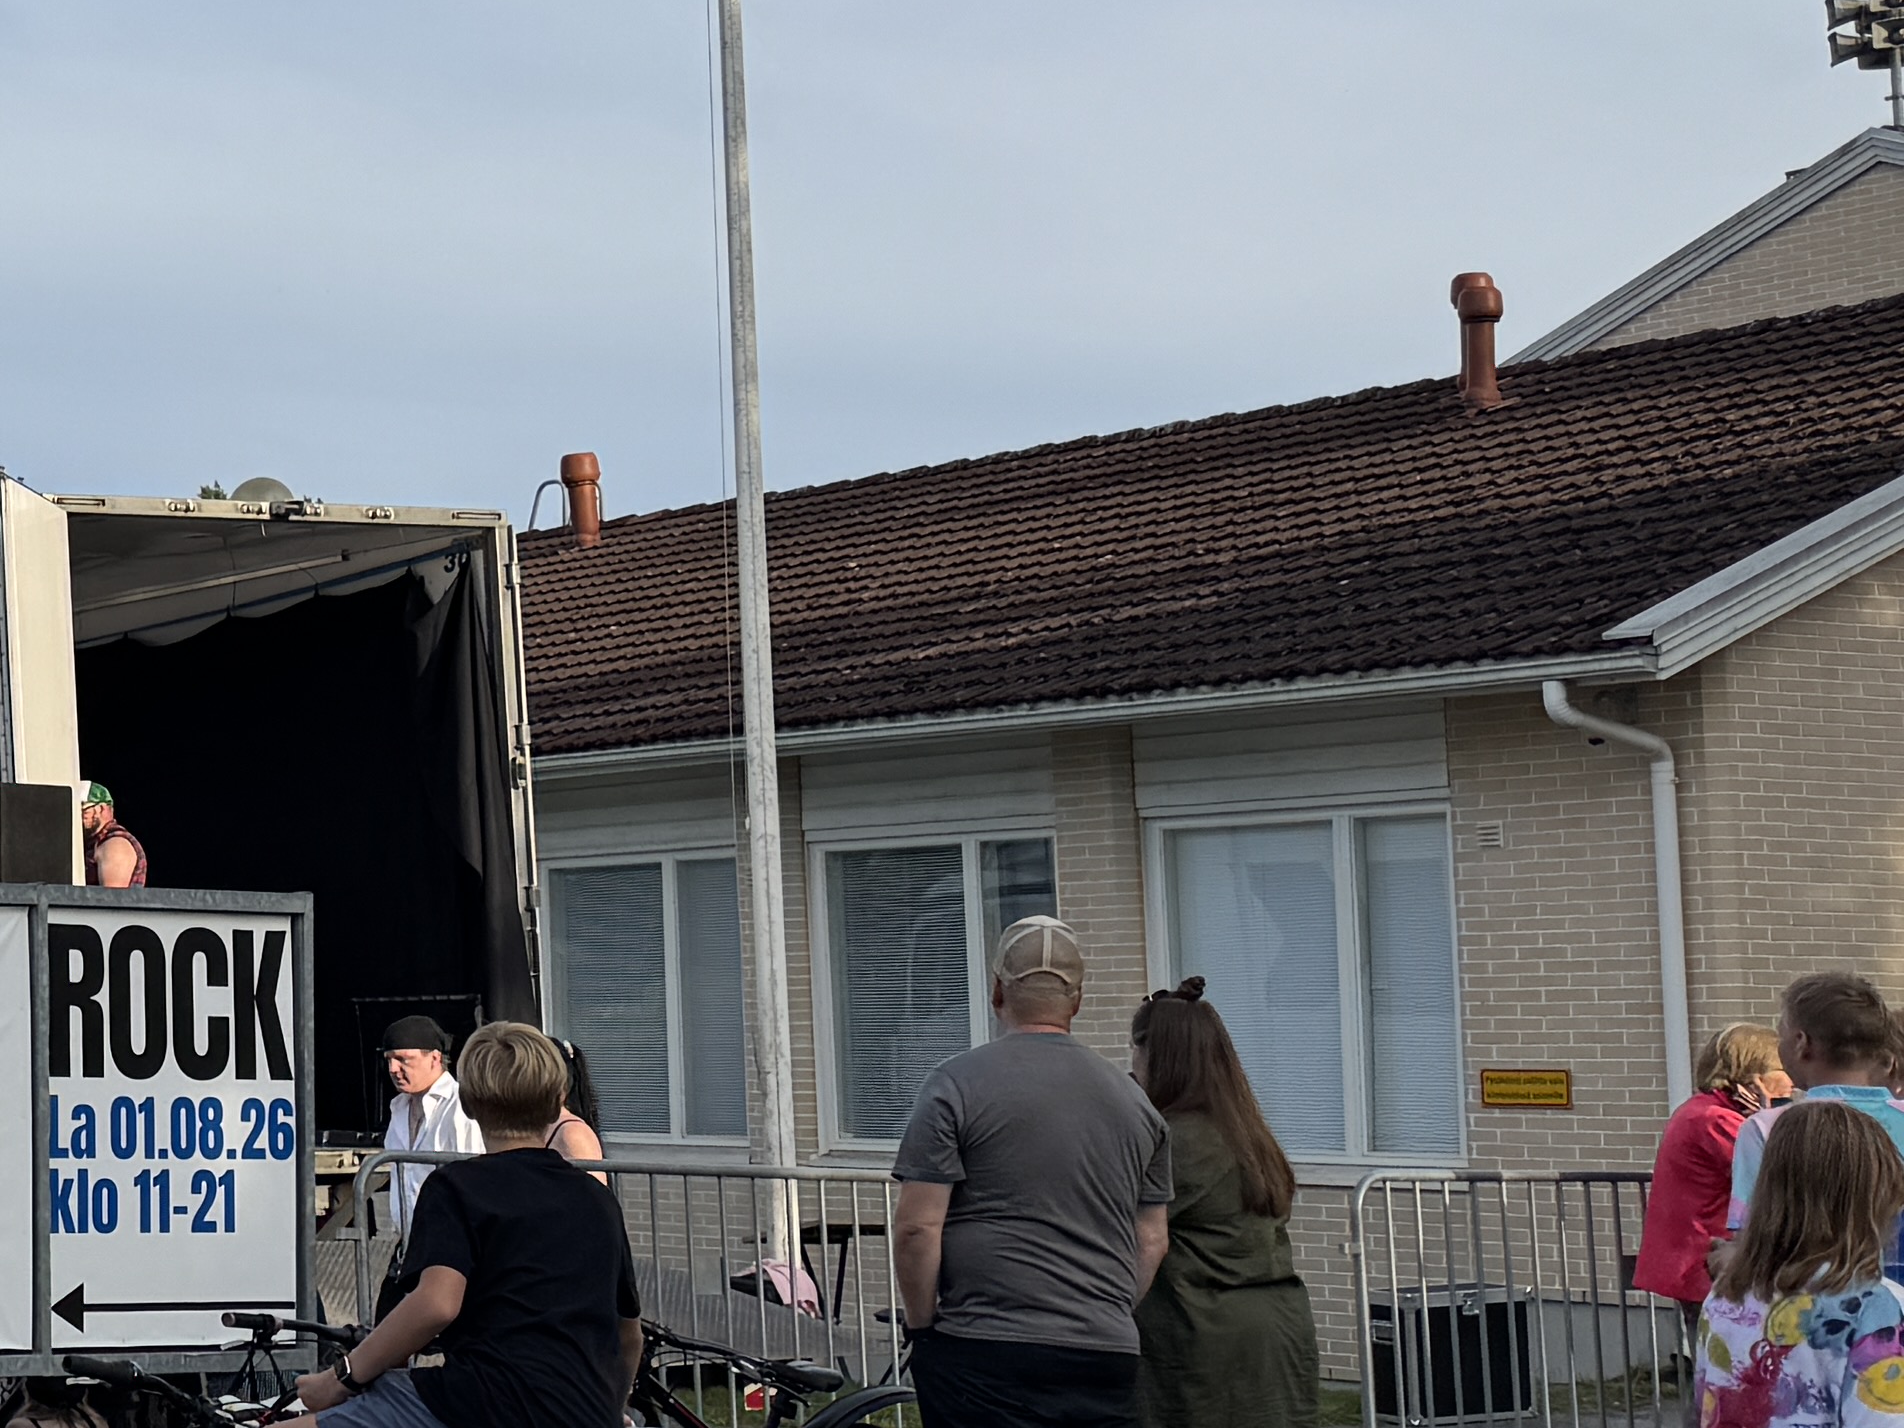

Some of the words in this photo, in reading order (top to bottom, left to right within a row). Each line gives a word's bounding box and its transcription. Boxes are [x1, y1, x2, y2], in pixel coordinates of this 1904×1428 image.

[48, 923, 294, 1080] ROCK
[49, 1094, 96, 1159] La
[110, 1095, 296, 1160] 01.08.26
[49, 1168, 119, 1234] klo
[134, 1169, 237, 1233] 11-21
